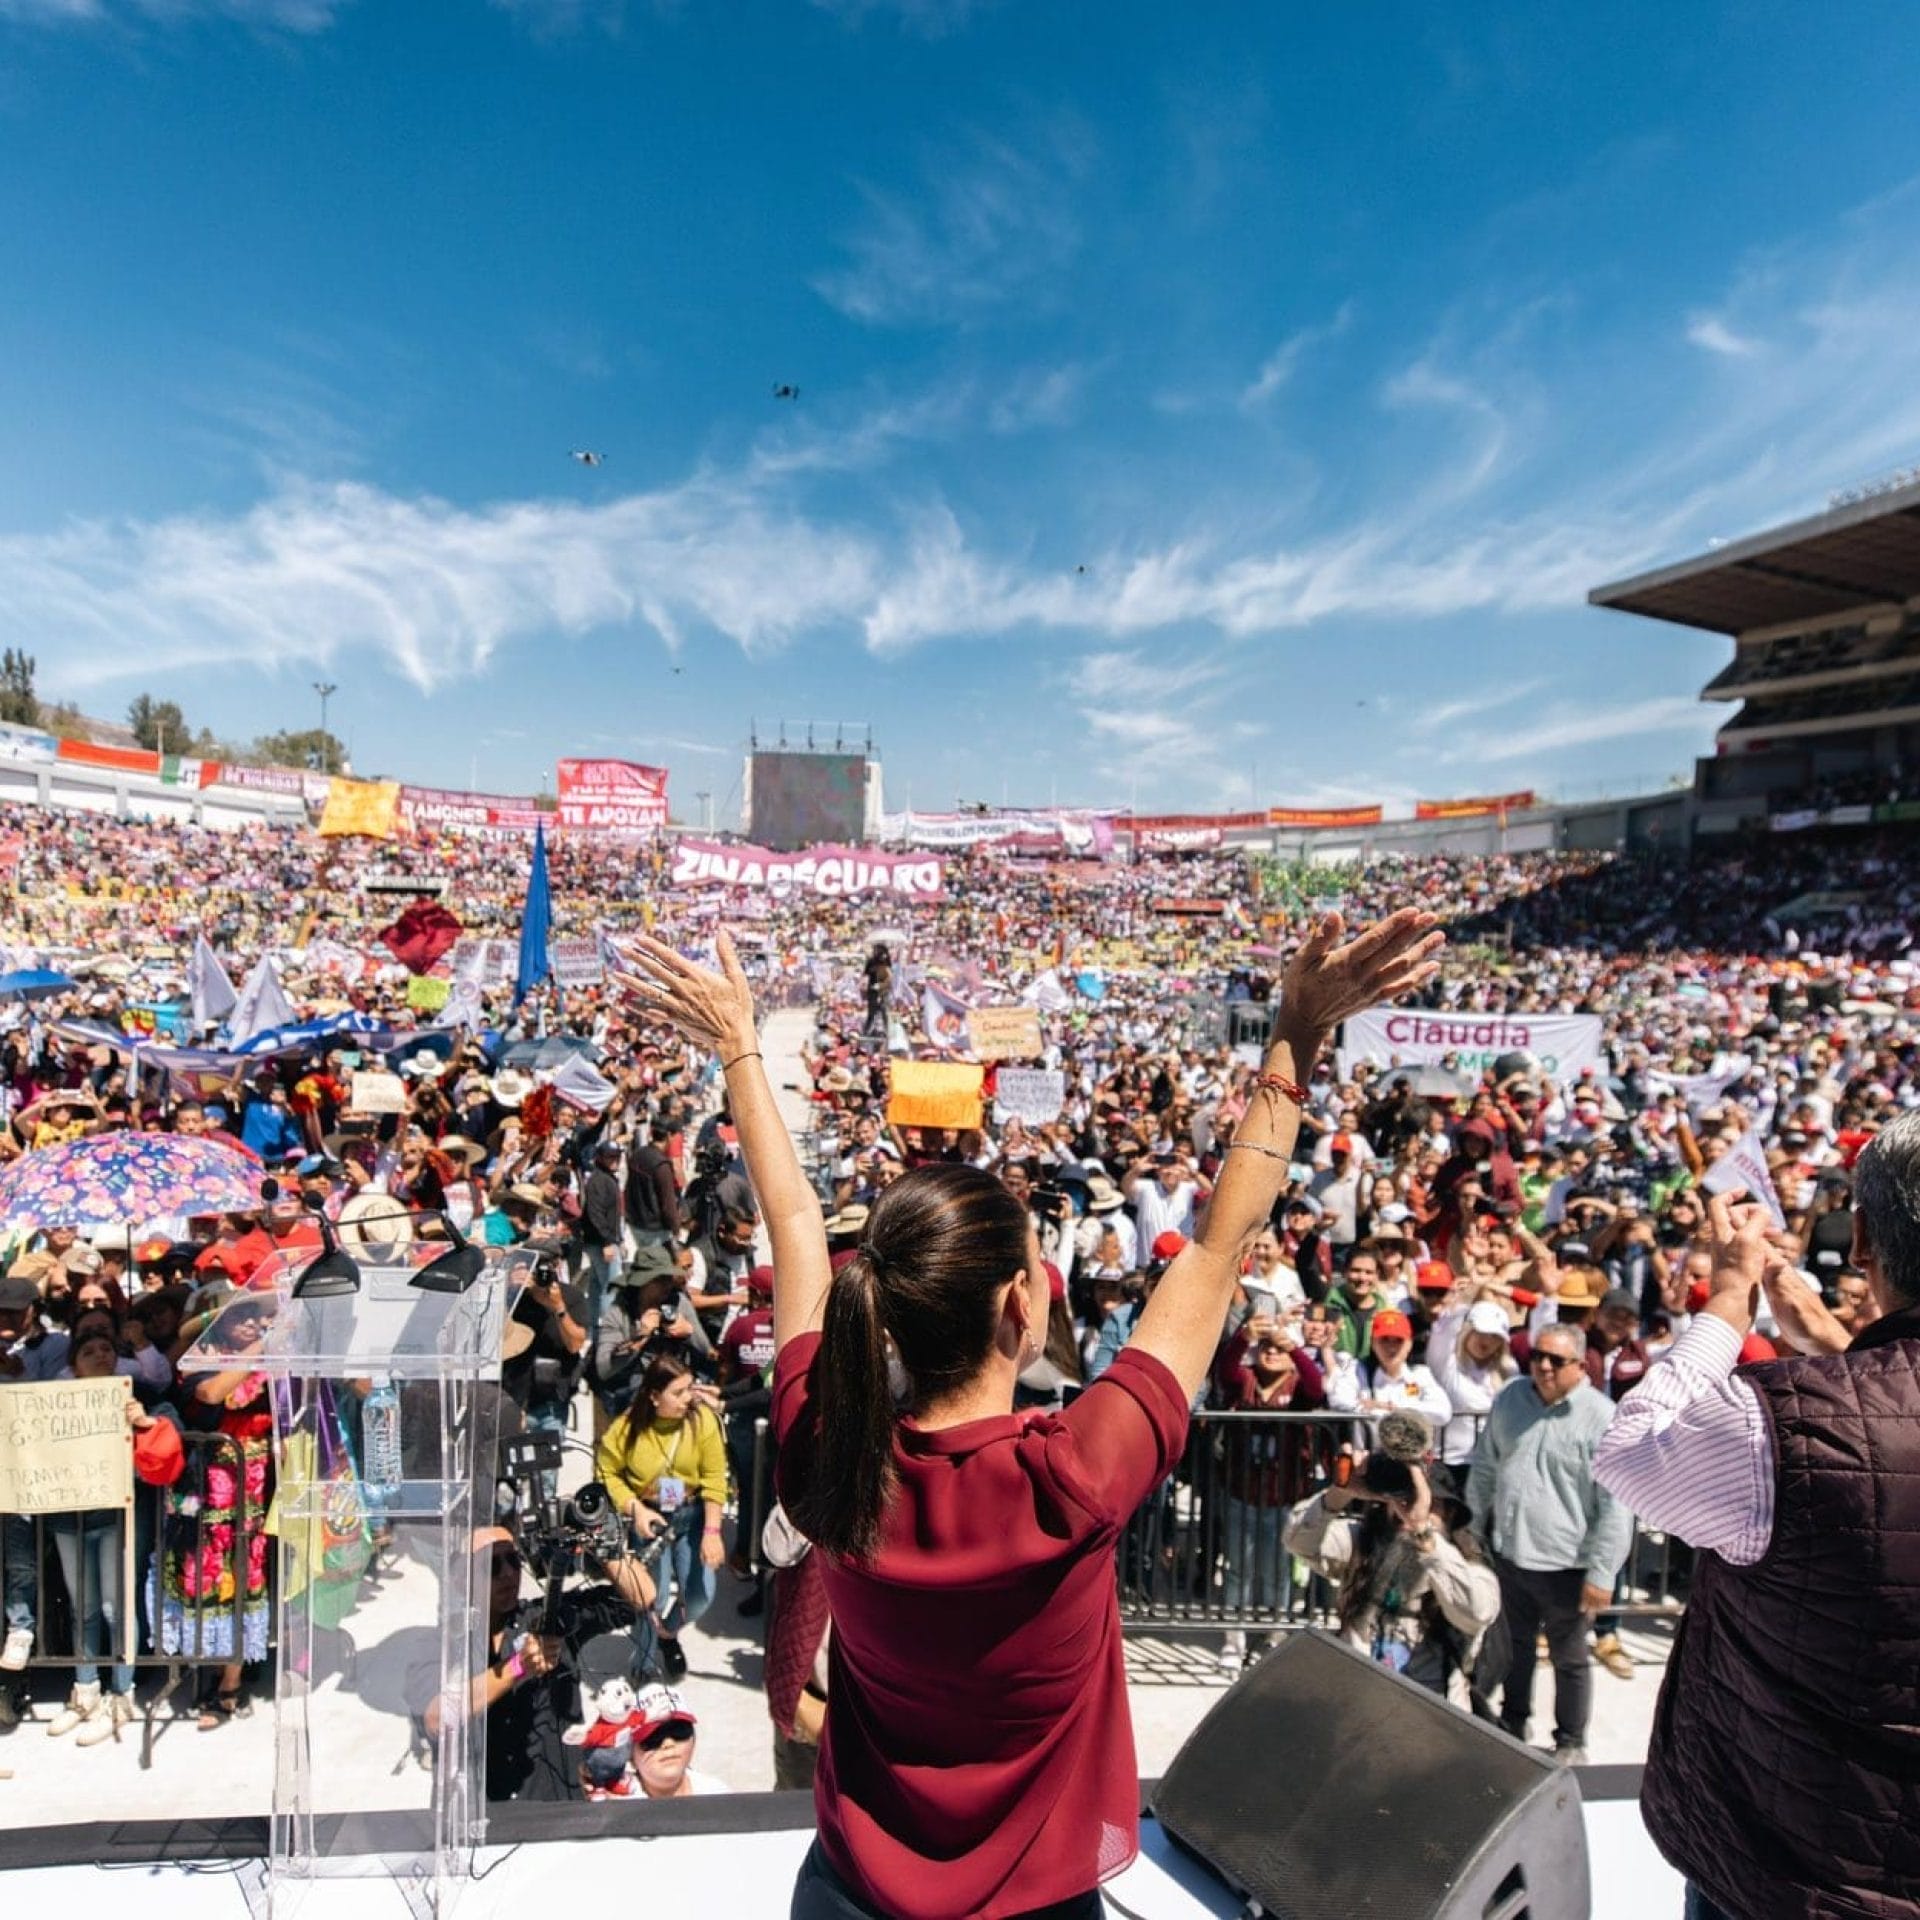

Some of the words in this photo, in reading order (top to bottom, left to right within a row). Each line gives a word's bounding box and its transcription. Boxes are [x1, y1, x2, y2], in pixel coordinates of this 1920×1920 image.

[400, 800, 488, 825] RAMONES
[562, 805, 585, 824] TE
[589, 806, 665, 826] APOYAN
[1386, 1014, 1531, 1048] Claudia
